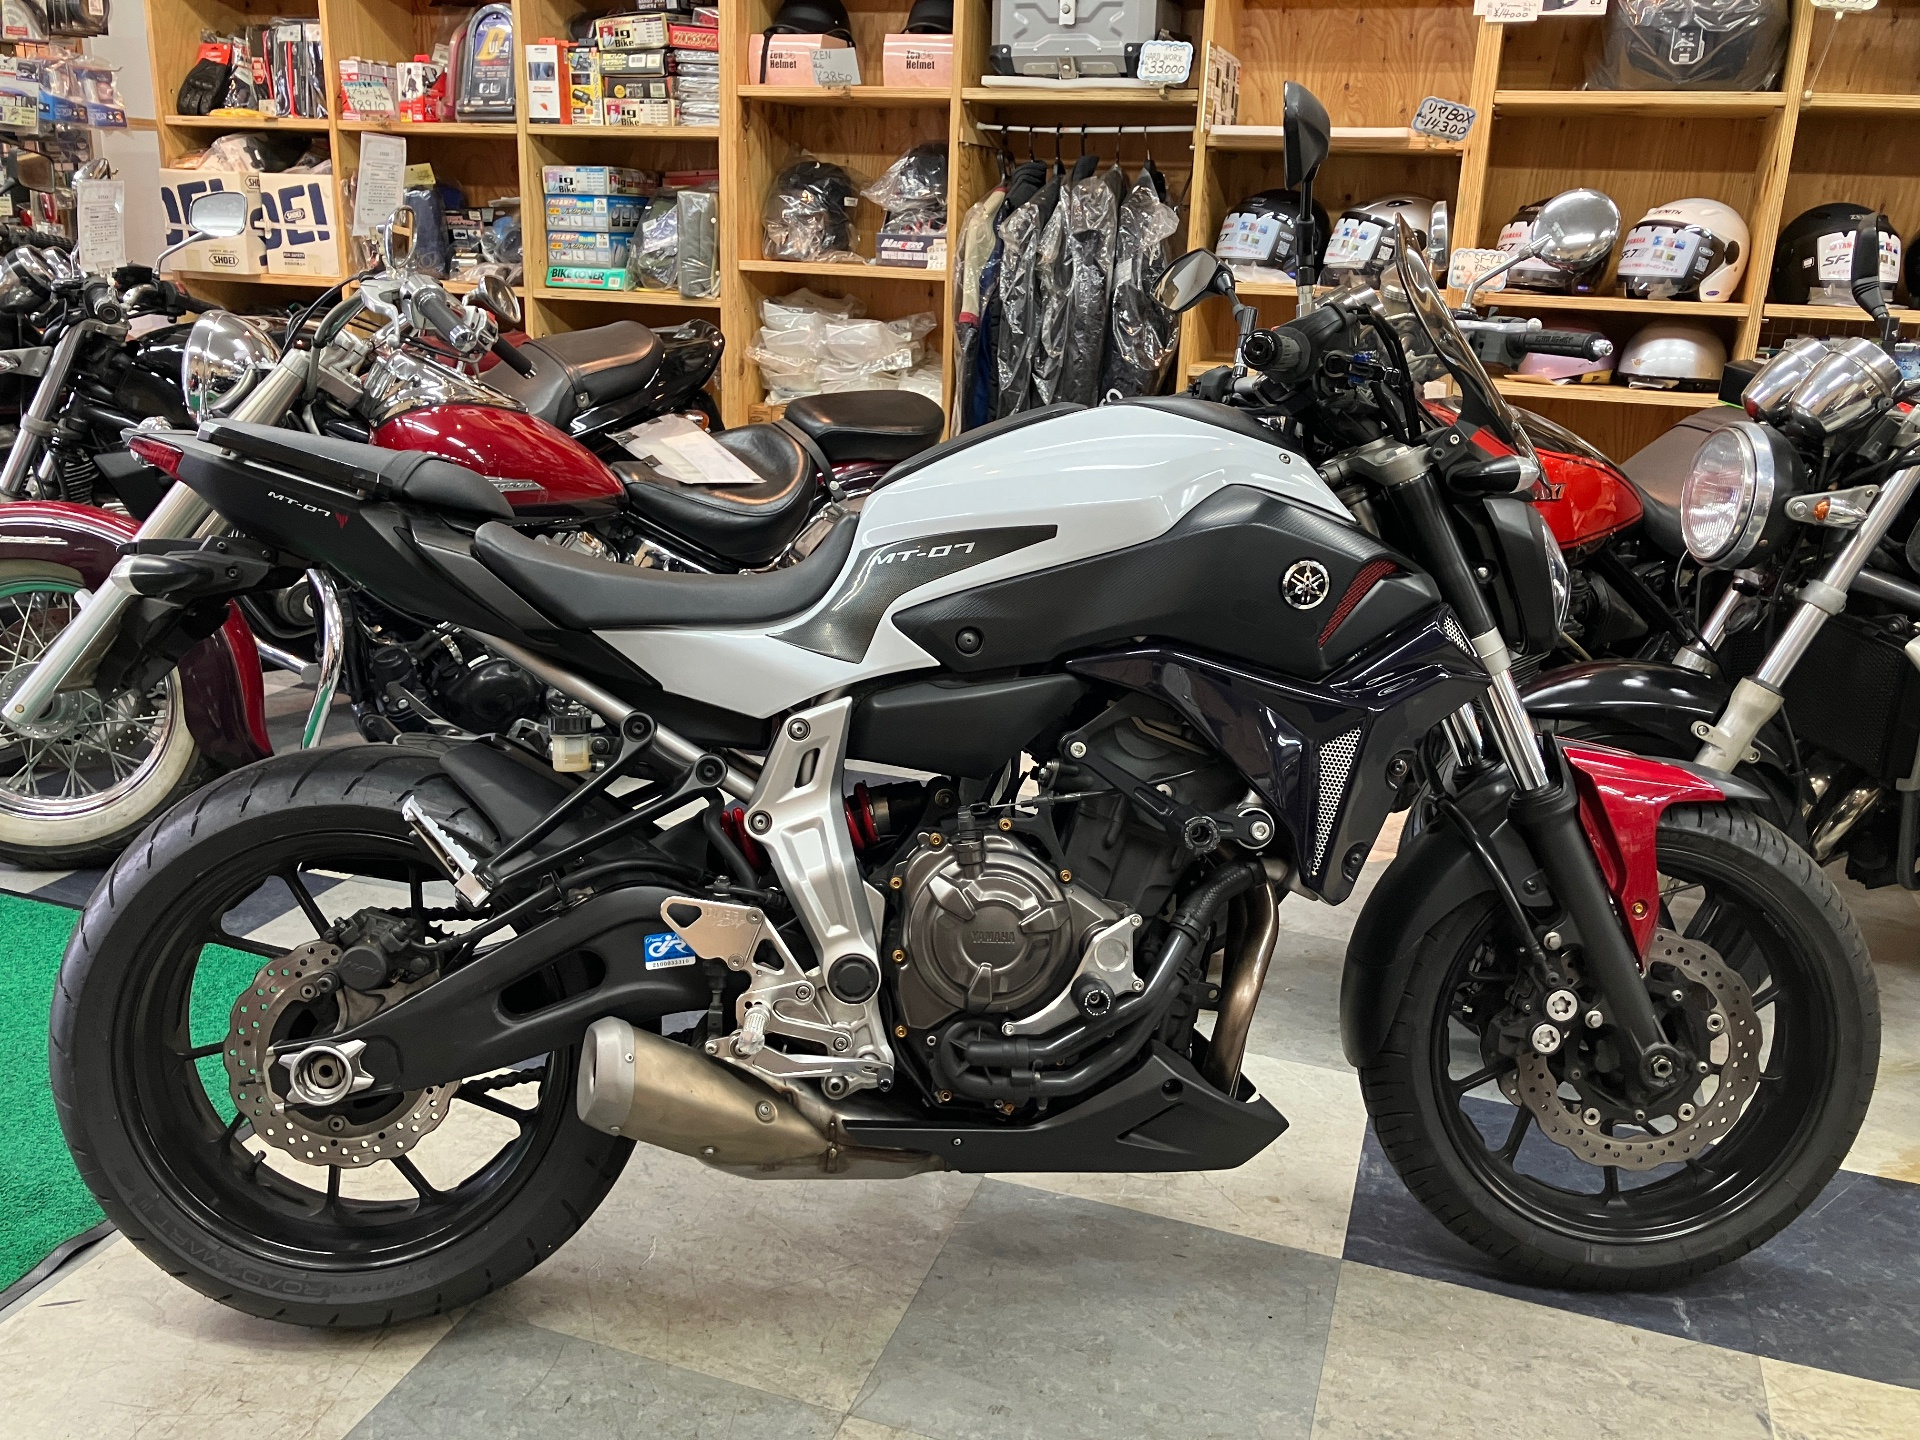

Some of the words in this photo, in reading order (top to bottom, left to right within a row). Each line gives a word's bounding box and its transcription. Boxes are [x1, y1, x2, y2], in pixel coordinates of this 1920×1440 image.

[615, 39, 634, 47] Bike
[770, 50, 783, 59] Zen
[812, 50, 832, 60] ZEN
[906, 50, 921, 60] Zen
[770, 60, 797, 69] Helmet
[906, 60, 935, 69] Helmet
[621, 118, 640, 127] Bike
[558, 185, 576, 193] Bike
[213, 255, 237, 265] SHOEI
[551, 268, 572, 278] BIKE
[574, 269, 605, 281] COVER
[267, 491, 331, 517] MT-07
[873, 541, 976, 565] MT-07
[970, 931, 1015, 944] YAMAHA
